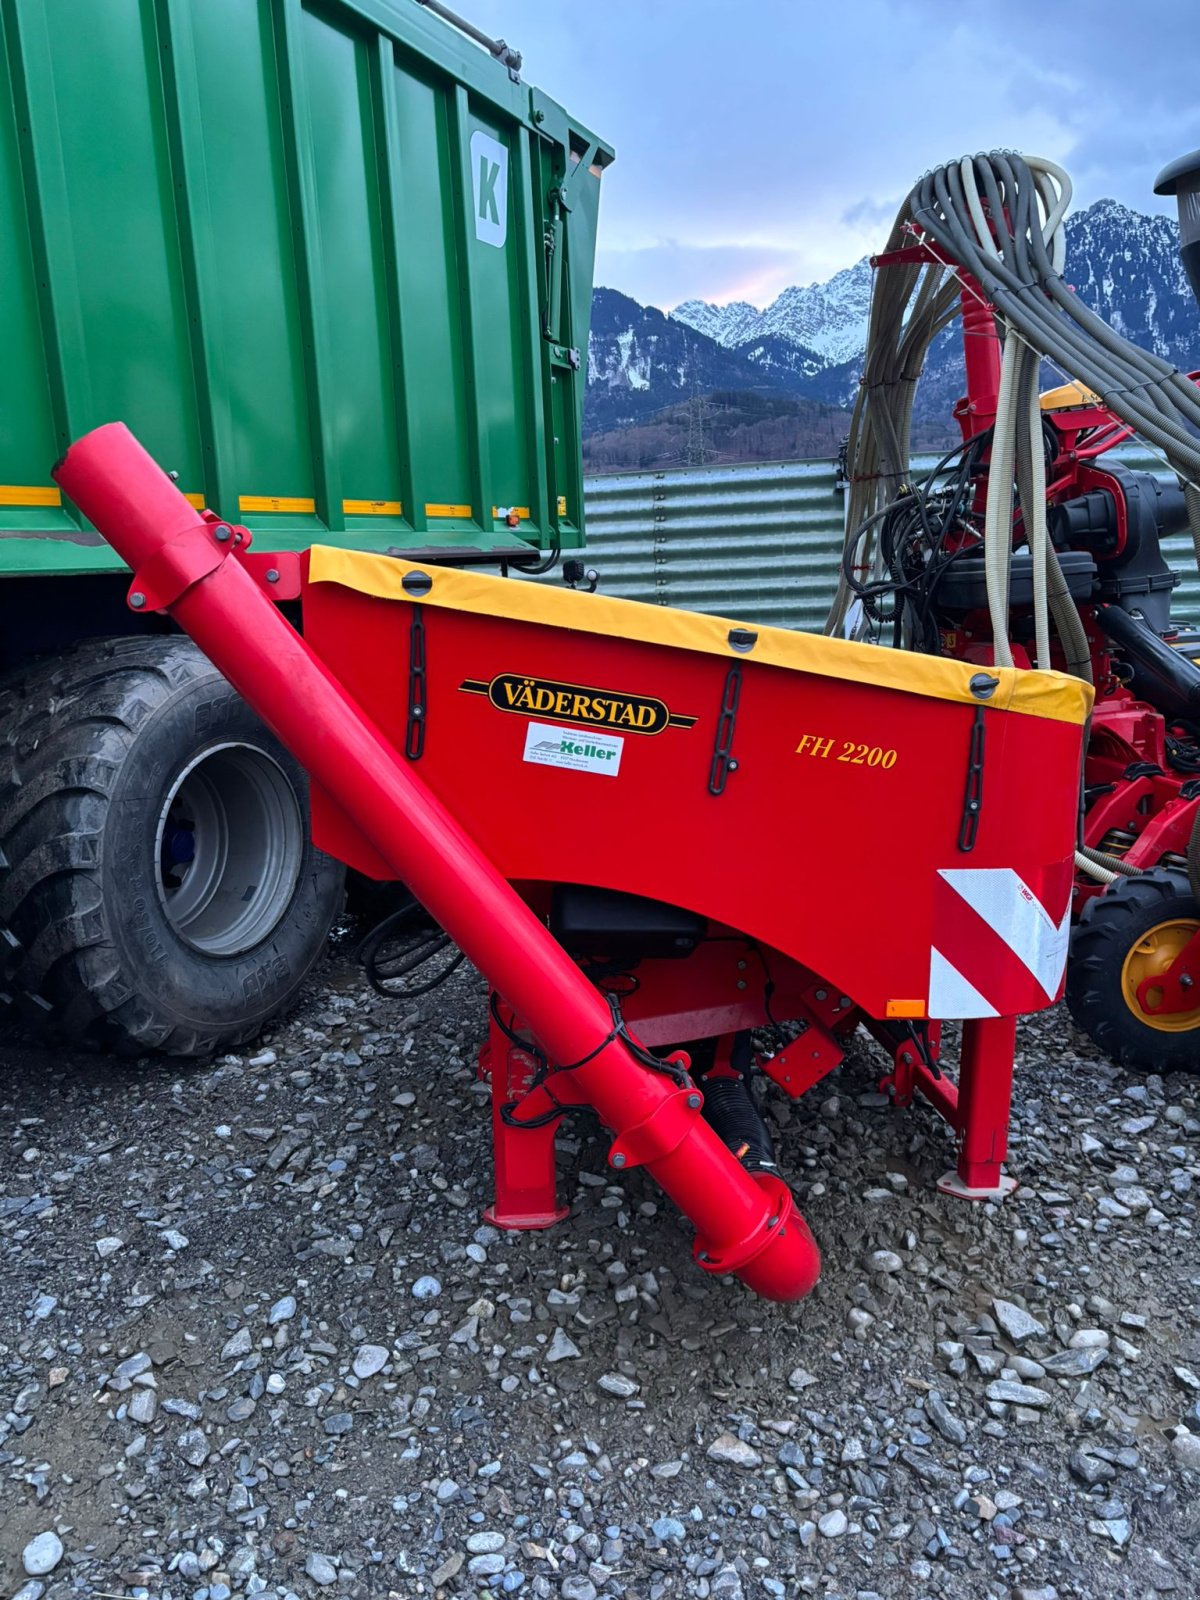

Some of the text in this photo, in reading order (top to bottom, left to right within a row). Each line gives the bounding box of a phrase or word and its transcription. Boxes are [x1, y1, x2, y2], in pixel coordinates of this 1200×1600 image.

[479, 155, 501, 226] K
[504, 680, 657, 728] VÄDERSTAD
[560, 740, 616, 760] Keller
[795, 734, 898, 769] FH 2200
